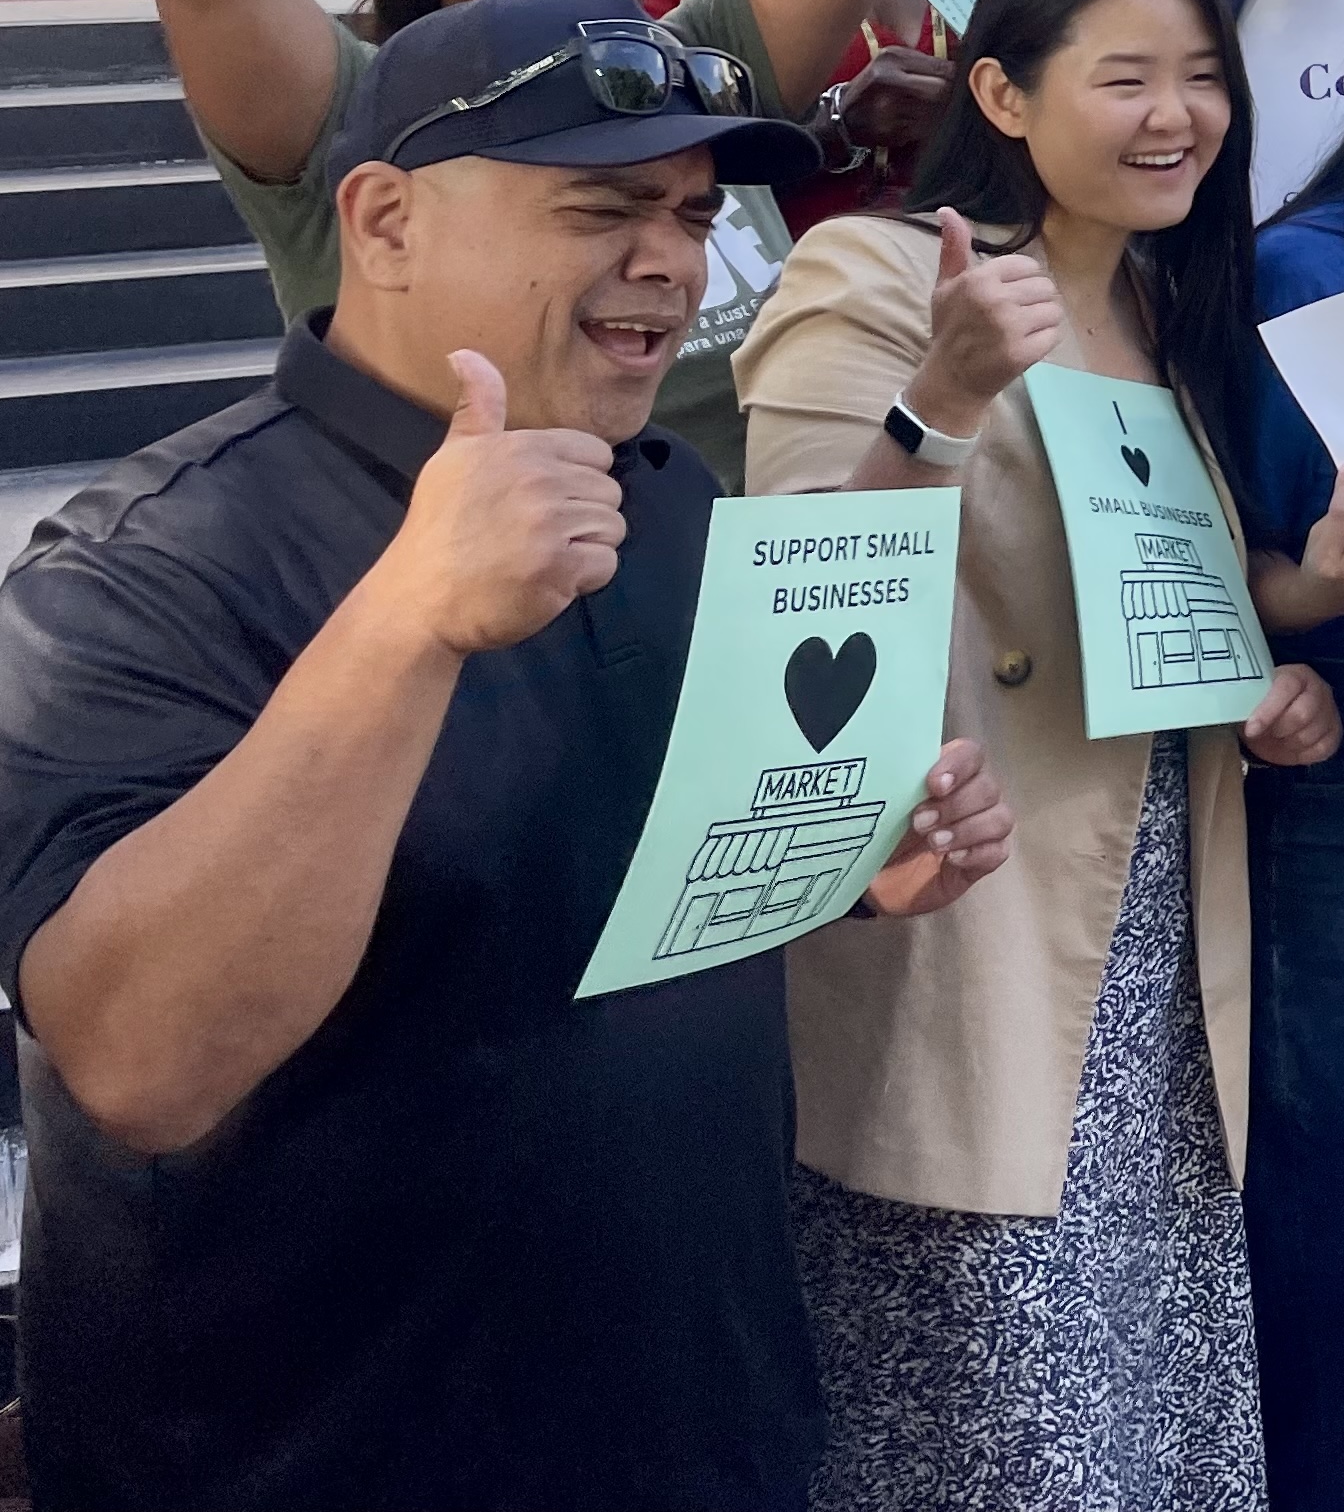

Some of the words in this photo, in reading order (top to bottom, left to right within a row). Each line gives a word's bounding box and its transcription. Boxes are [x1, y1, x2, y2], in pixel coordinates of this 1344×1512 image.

[714, 303, 751, 325] Just
[1112, 401, 1127, 435] I
[1089, 496, 1140, 517] SMALL
[1141, 501, 1213, 528] BUSINESSES
[752, 534, 863, 567] SUPPORT
[866, 531, 935, 560] SMALL
[1140, 537, 1198, 565] MARKET
[772, 578, 909, 614] BUSINESSES
[763, 763, 858, 802] MARKET
